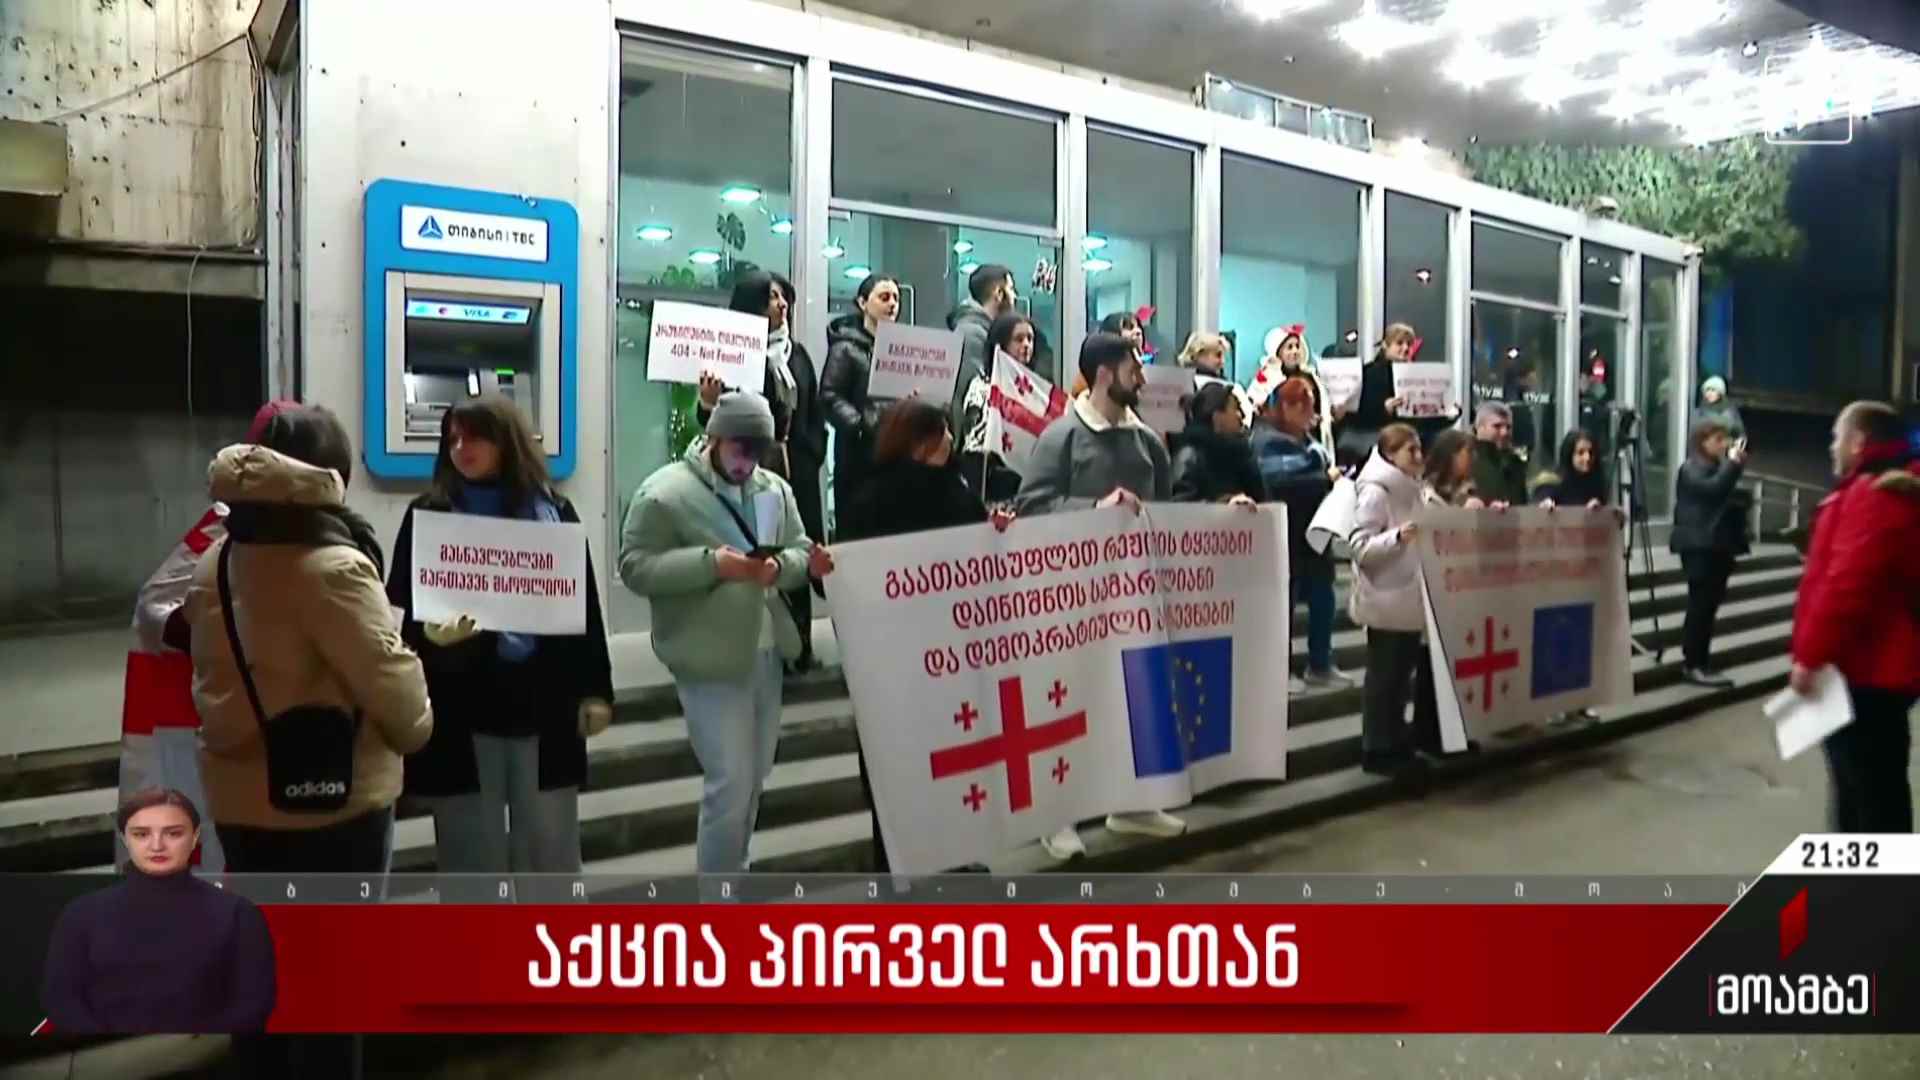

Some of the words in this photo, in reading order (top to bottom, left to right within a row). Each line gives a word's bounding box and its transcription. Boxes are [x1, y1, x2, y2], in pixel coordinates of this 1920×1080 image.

[448, 223, 503, 242] თიბისი
[512, 231, 536, 246] TBC
[670, 343, 690, 358] 404
[886, 538, 1099, 600] გაათავისუფლეთ
[953, 577, 1087, 630] დაინიშნოს
[924, 647, 960, 678] და
[965, 608, 1151, 669] დემოკრატიული
[285, 780, 346, 797] adidas
